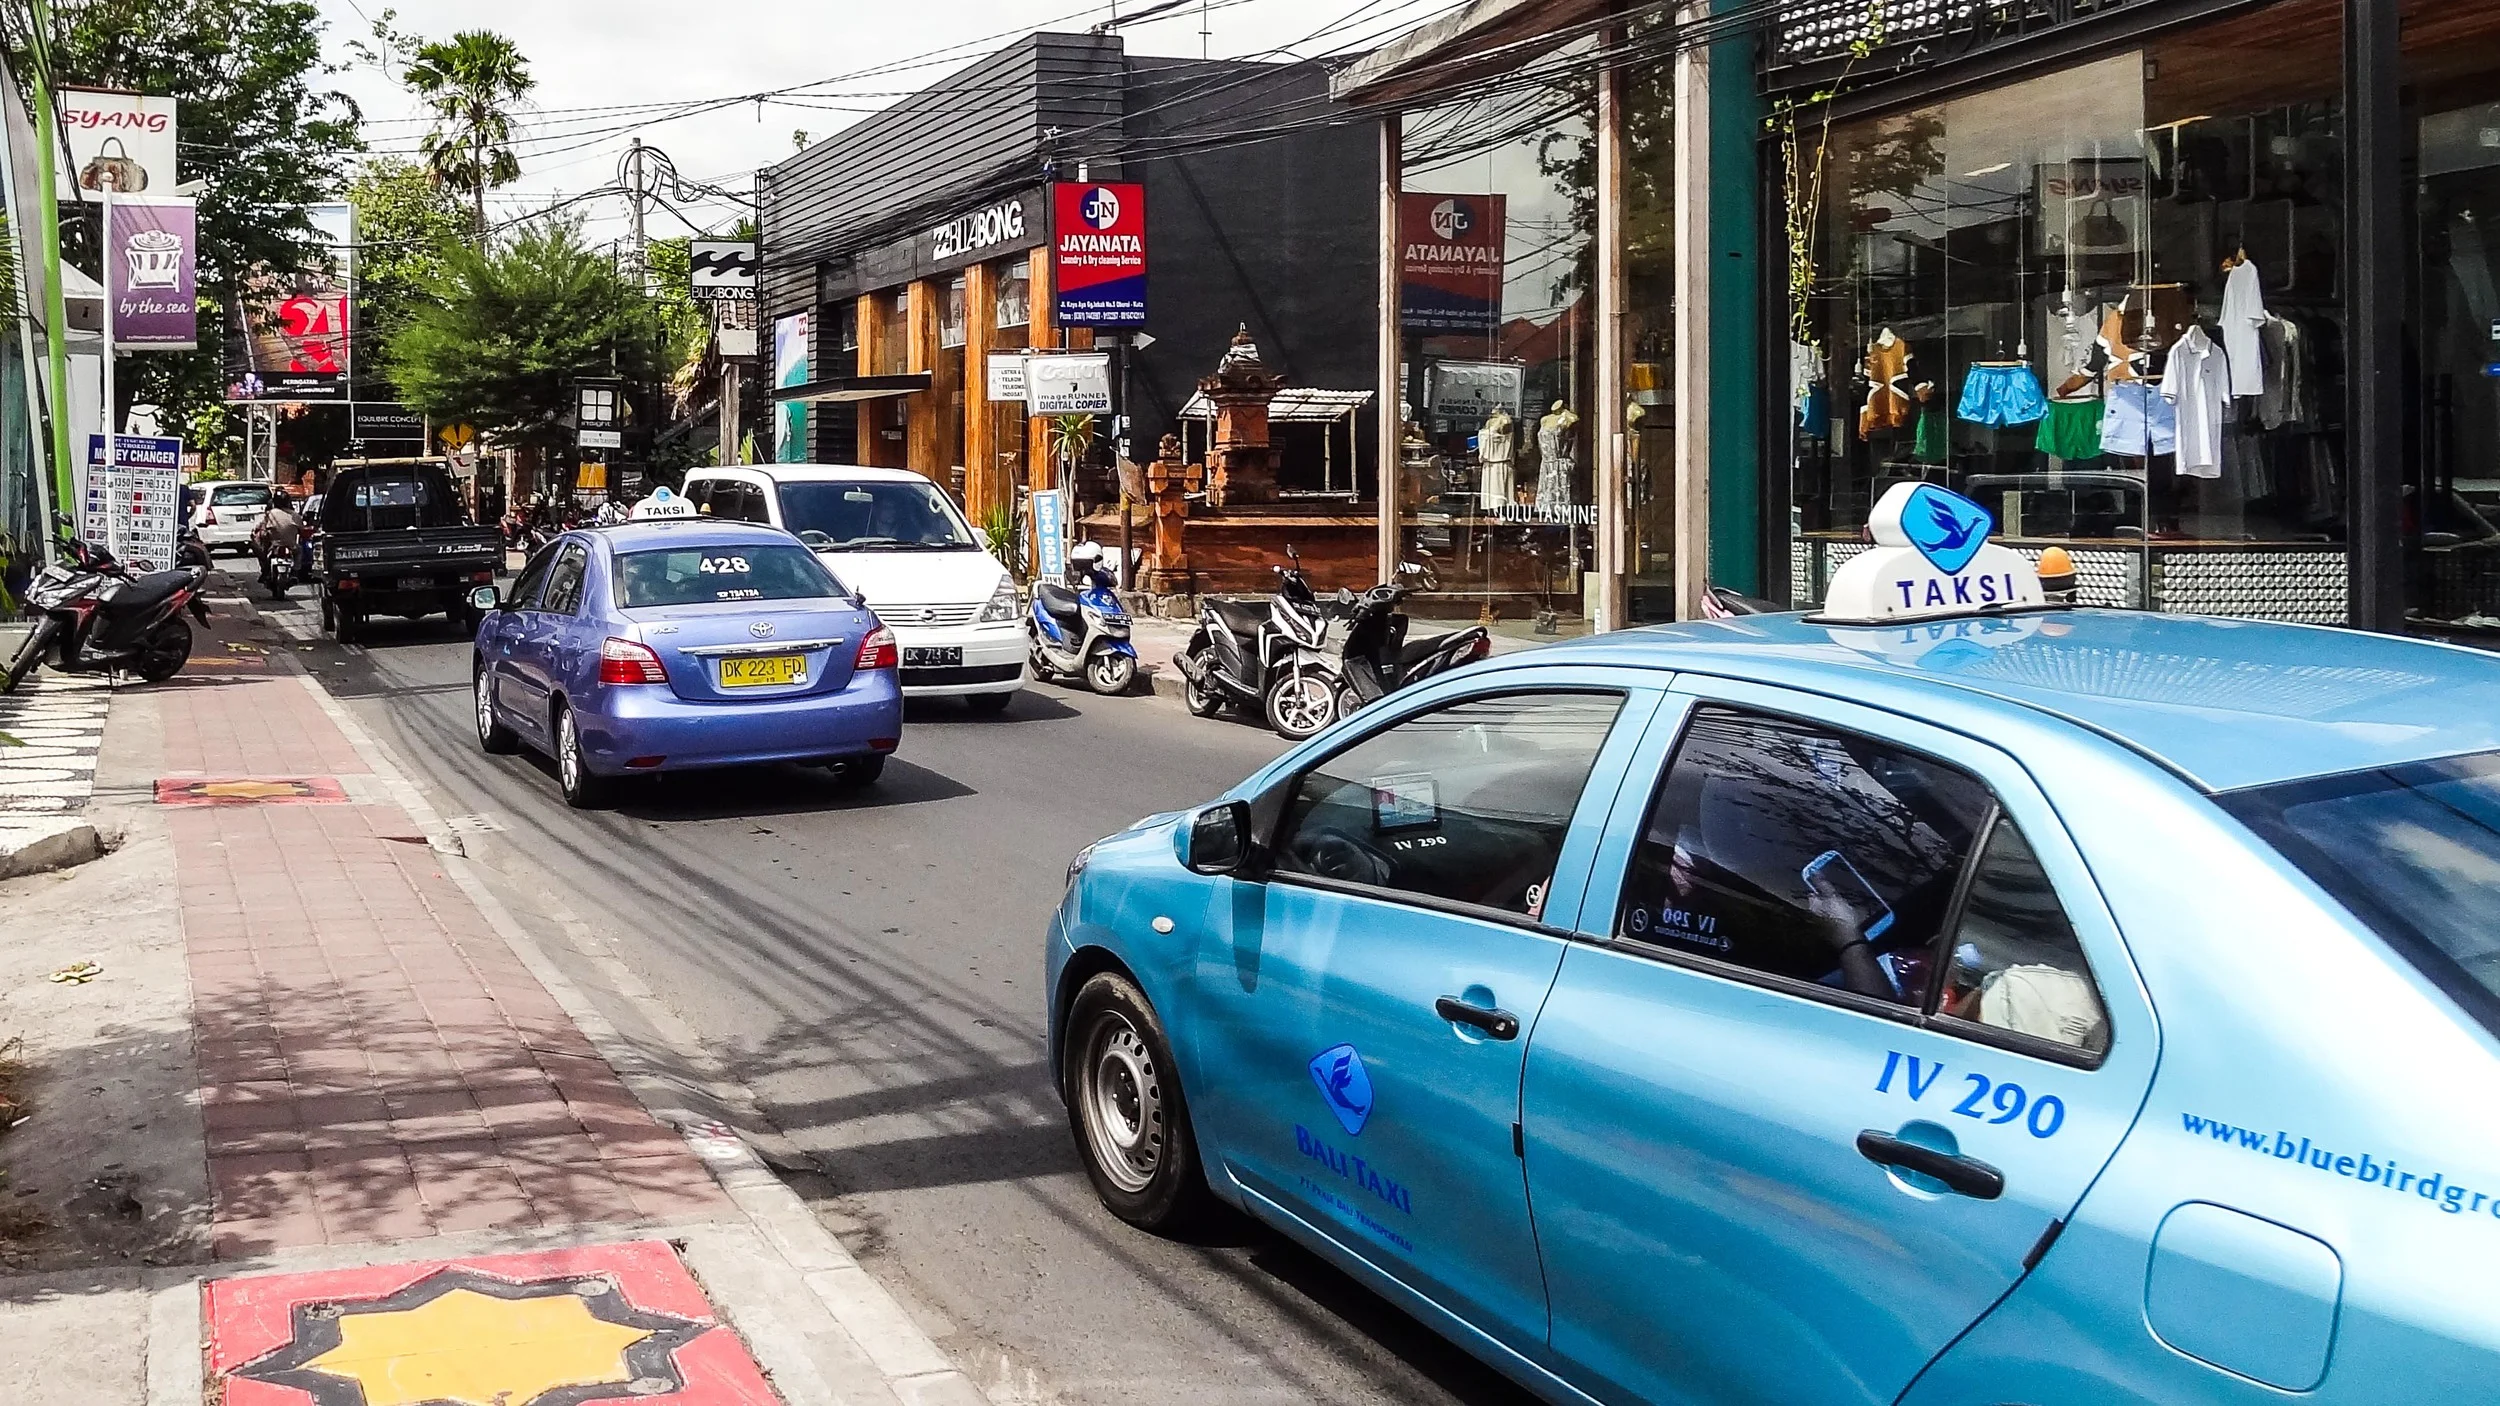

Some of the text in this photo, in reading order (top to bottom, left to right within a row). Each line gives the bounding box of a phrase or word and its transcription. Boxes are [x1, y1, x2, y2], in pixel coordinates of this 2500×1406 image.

[60, 110, 168, 133] SYANG
[1085, 201, 1116, 219] JN
[1060, 234, 1142, 253] JAYANATA
[1060, 254, 1082, 267] Laundry
[1082, 254, 1088, 265] &
[1088, 254, 1098, 267] Dry
[1121, 254, 1142, 265] Service
[119, 297, 190, 318] by the sea
[1040, 400, 1108, 410] DIGITAL COPIER
[94, 447, 176, 465] MOEY CHANGER
[644, 506, 685, 516] TAKSI
[1499, 504, 1598, 525] LULU YASMINE
[700, 556, 751, 574] 428
[1896, 573, 2015, 609] TAKSI
[725, 660, 744, 678] DK
[748, 659, 776, 676] 223
[1394, 836, 1448, 850] IV 290
[1875, 1050, 2065, 1139] IV 290
[1295, 1123, 1411, 1215] BALI TAXI
